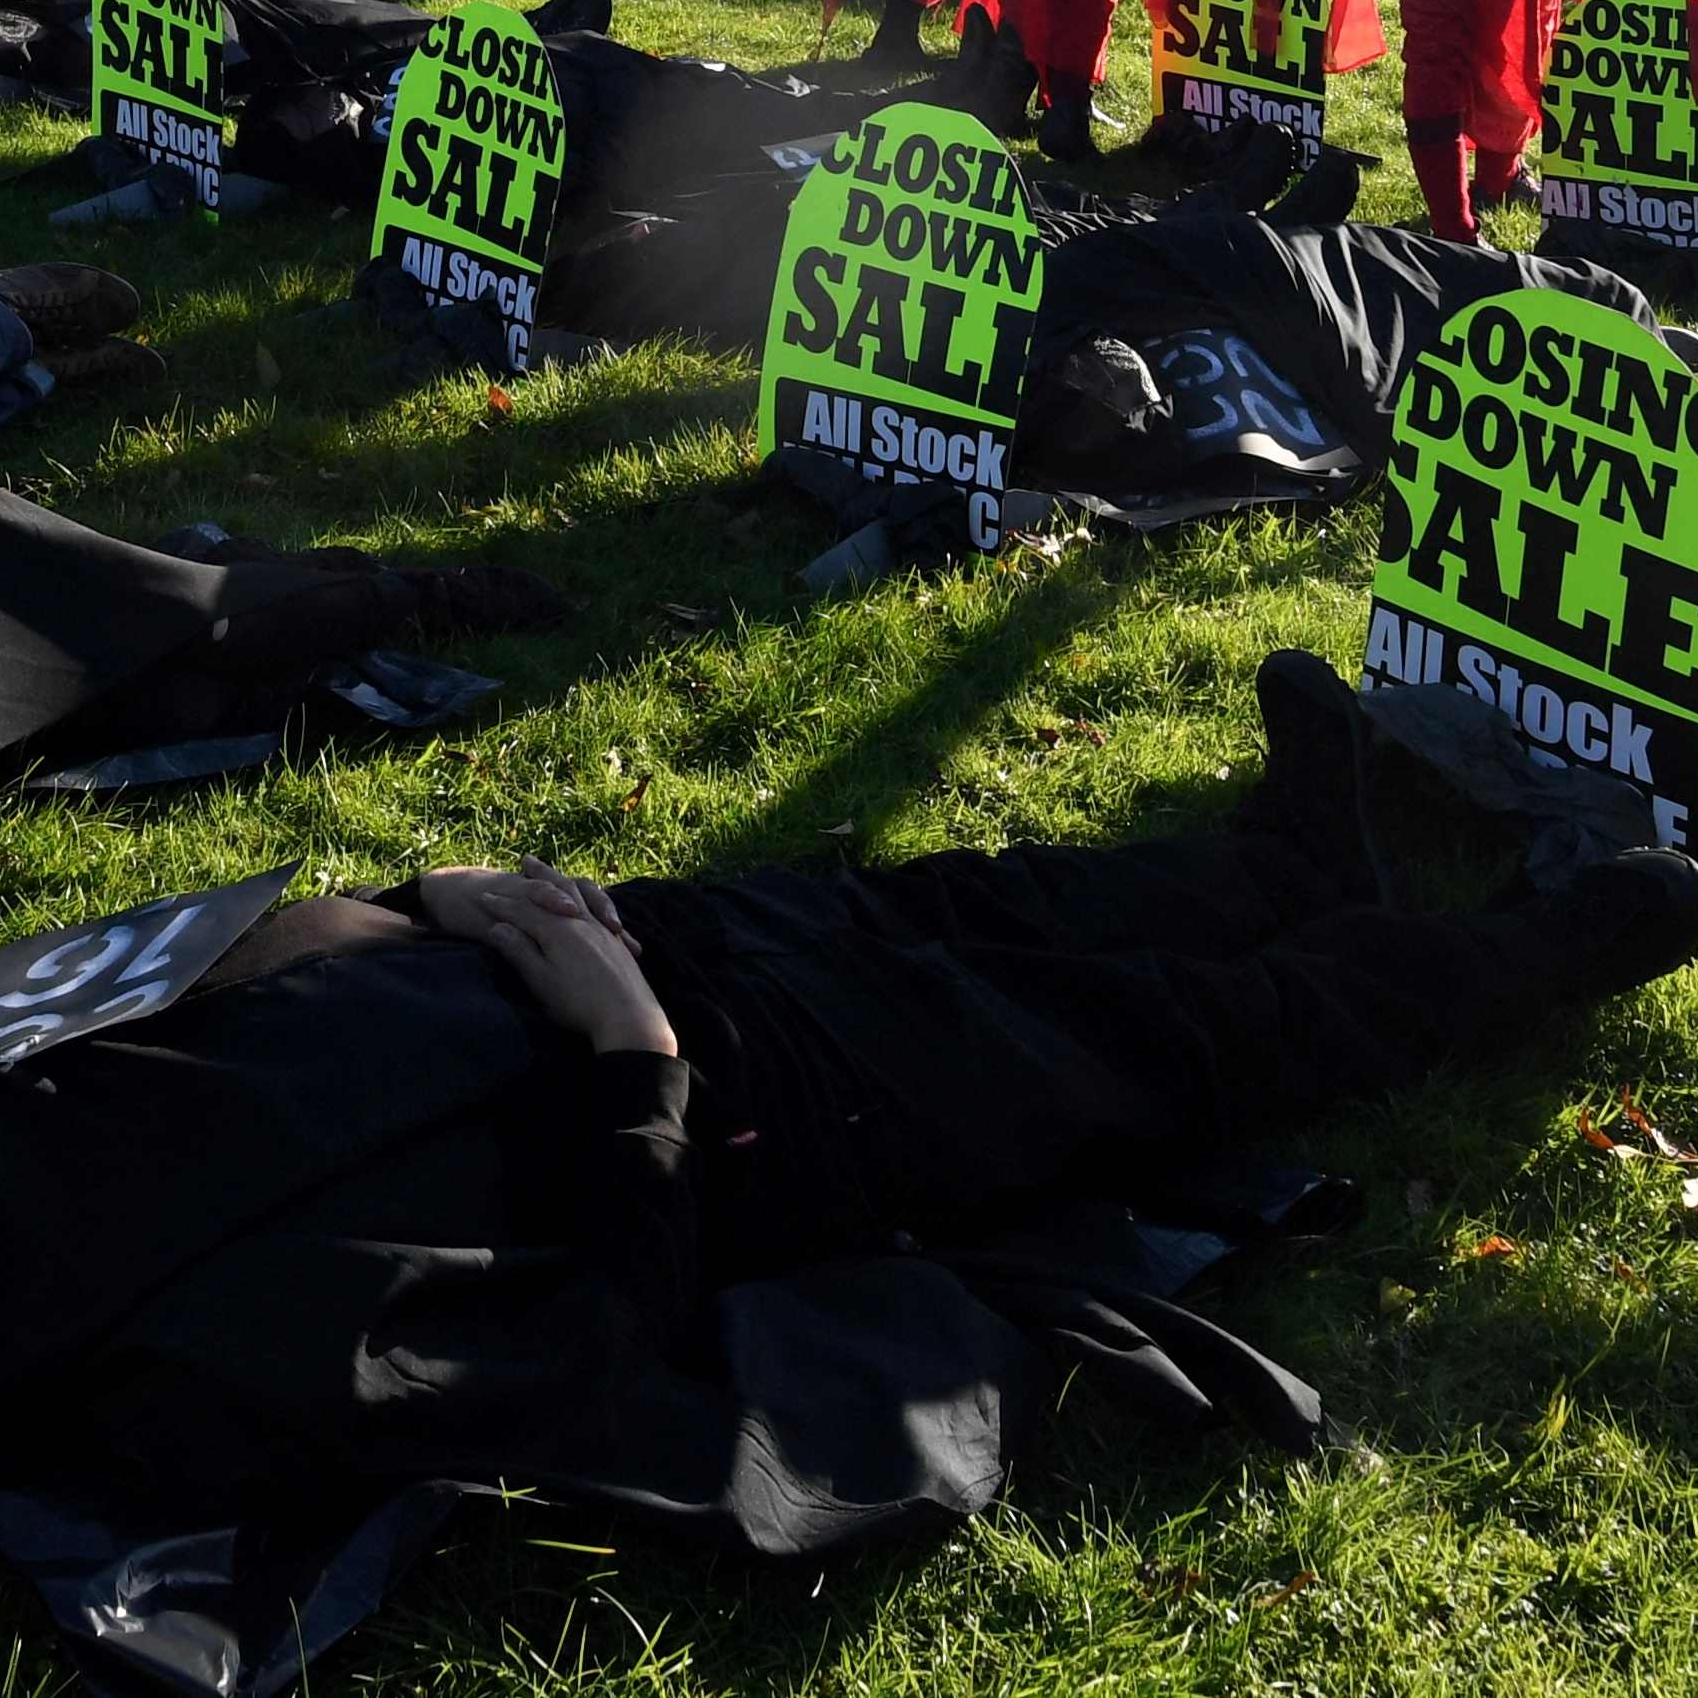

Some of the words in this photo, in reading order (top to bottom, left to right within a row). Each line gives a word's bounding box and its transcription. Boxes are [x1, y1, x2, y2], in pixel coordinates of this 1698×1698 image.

[116, 99, 148, 143] All
[153, 108, 220, 167] Stock
[435, 69, 564, 165] DOWN
[1183, 79, 1224, 117] All
[1229, 88, 1322, 138] Stock
[839, 187, 1043, 295] DOWN
[1542, 179, 1591, 220] All
[402, 236, 443, 290] All
[802, 389, 862, 453] All
[870, 405, 1007, 491] Stock
[1406, 360, 1678, 542] DOWN
[1364, 605, 1445, 684] All
[1456, 644, 1655, 786] Stock
